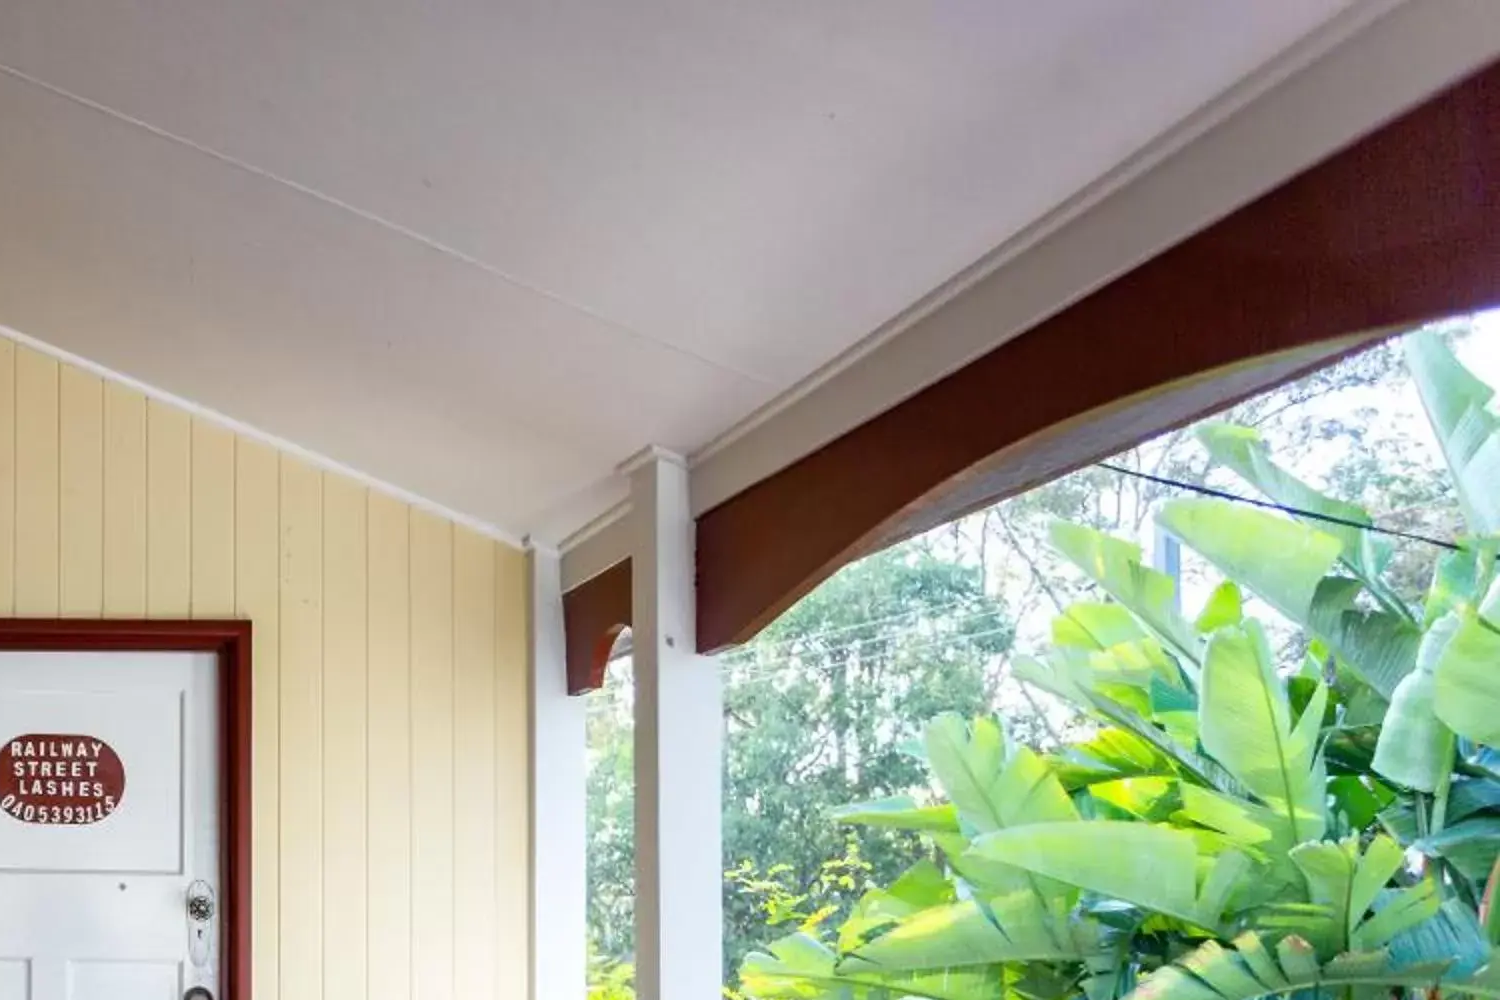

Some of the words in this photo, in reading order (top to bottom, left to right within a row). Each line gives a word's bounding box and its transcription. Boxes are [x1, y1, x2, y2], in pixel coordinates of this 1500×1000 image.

[11, 741, 103, 757] RAILWAY
[13, 761, 99, 777] STREET
[19, 780, 104, 797] LASHES
[1, 795, 115, 823] 0405393115
